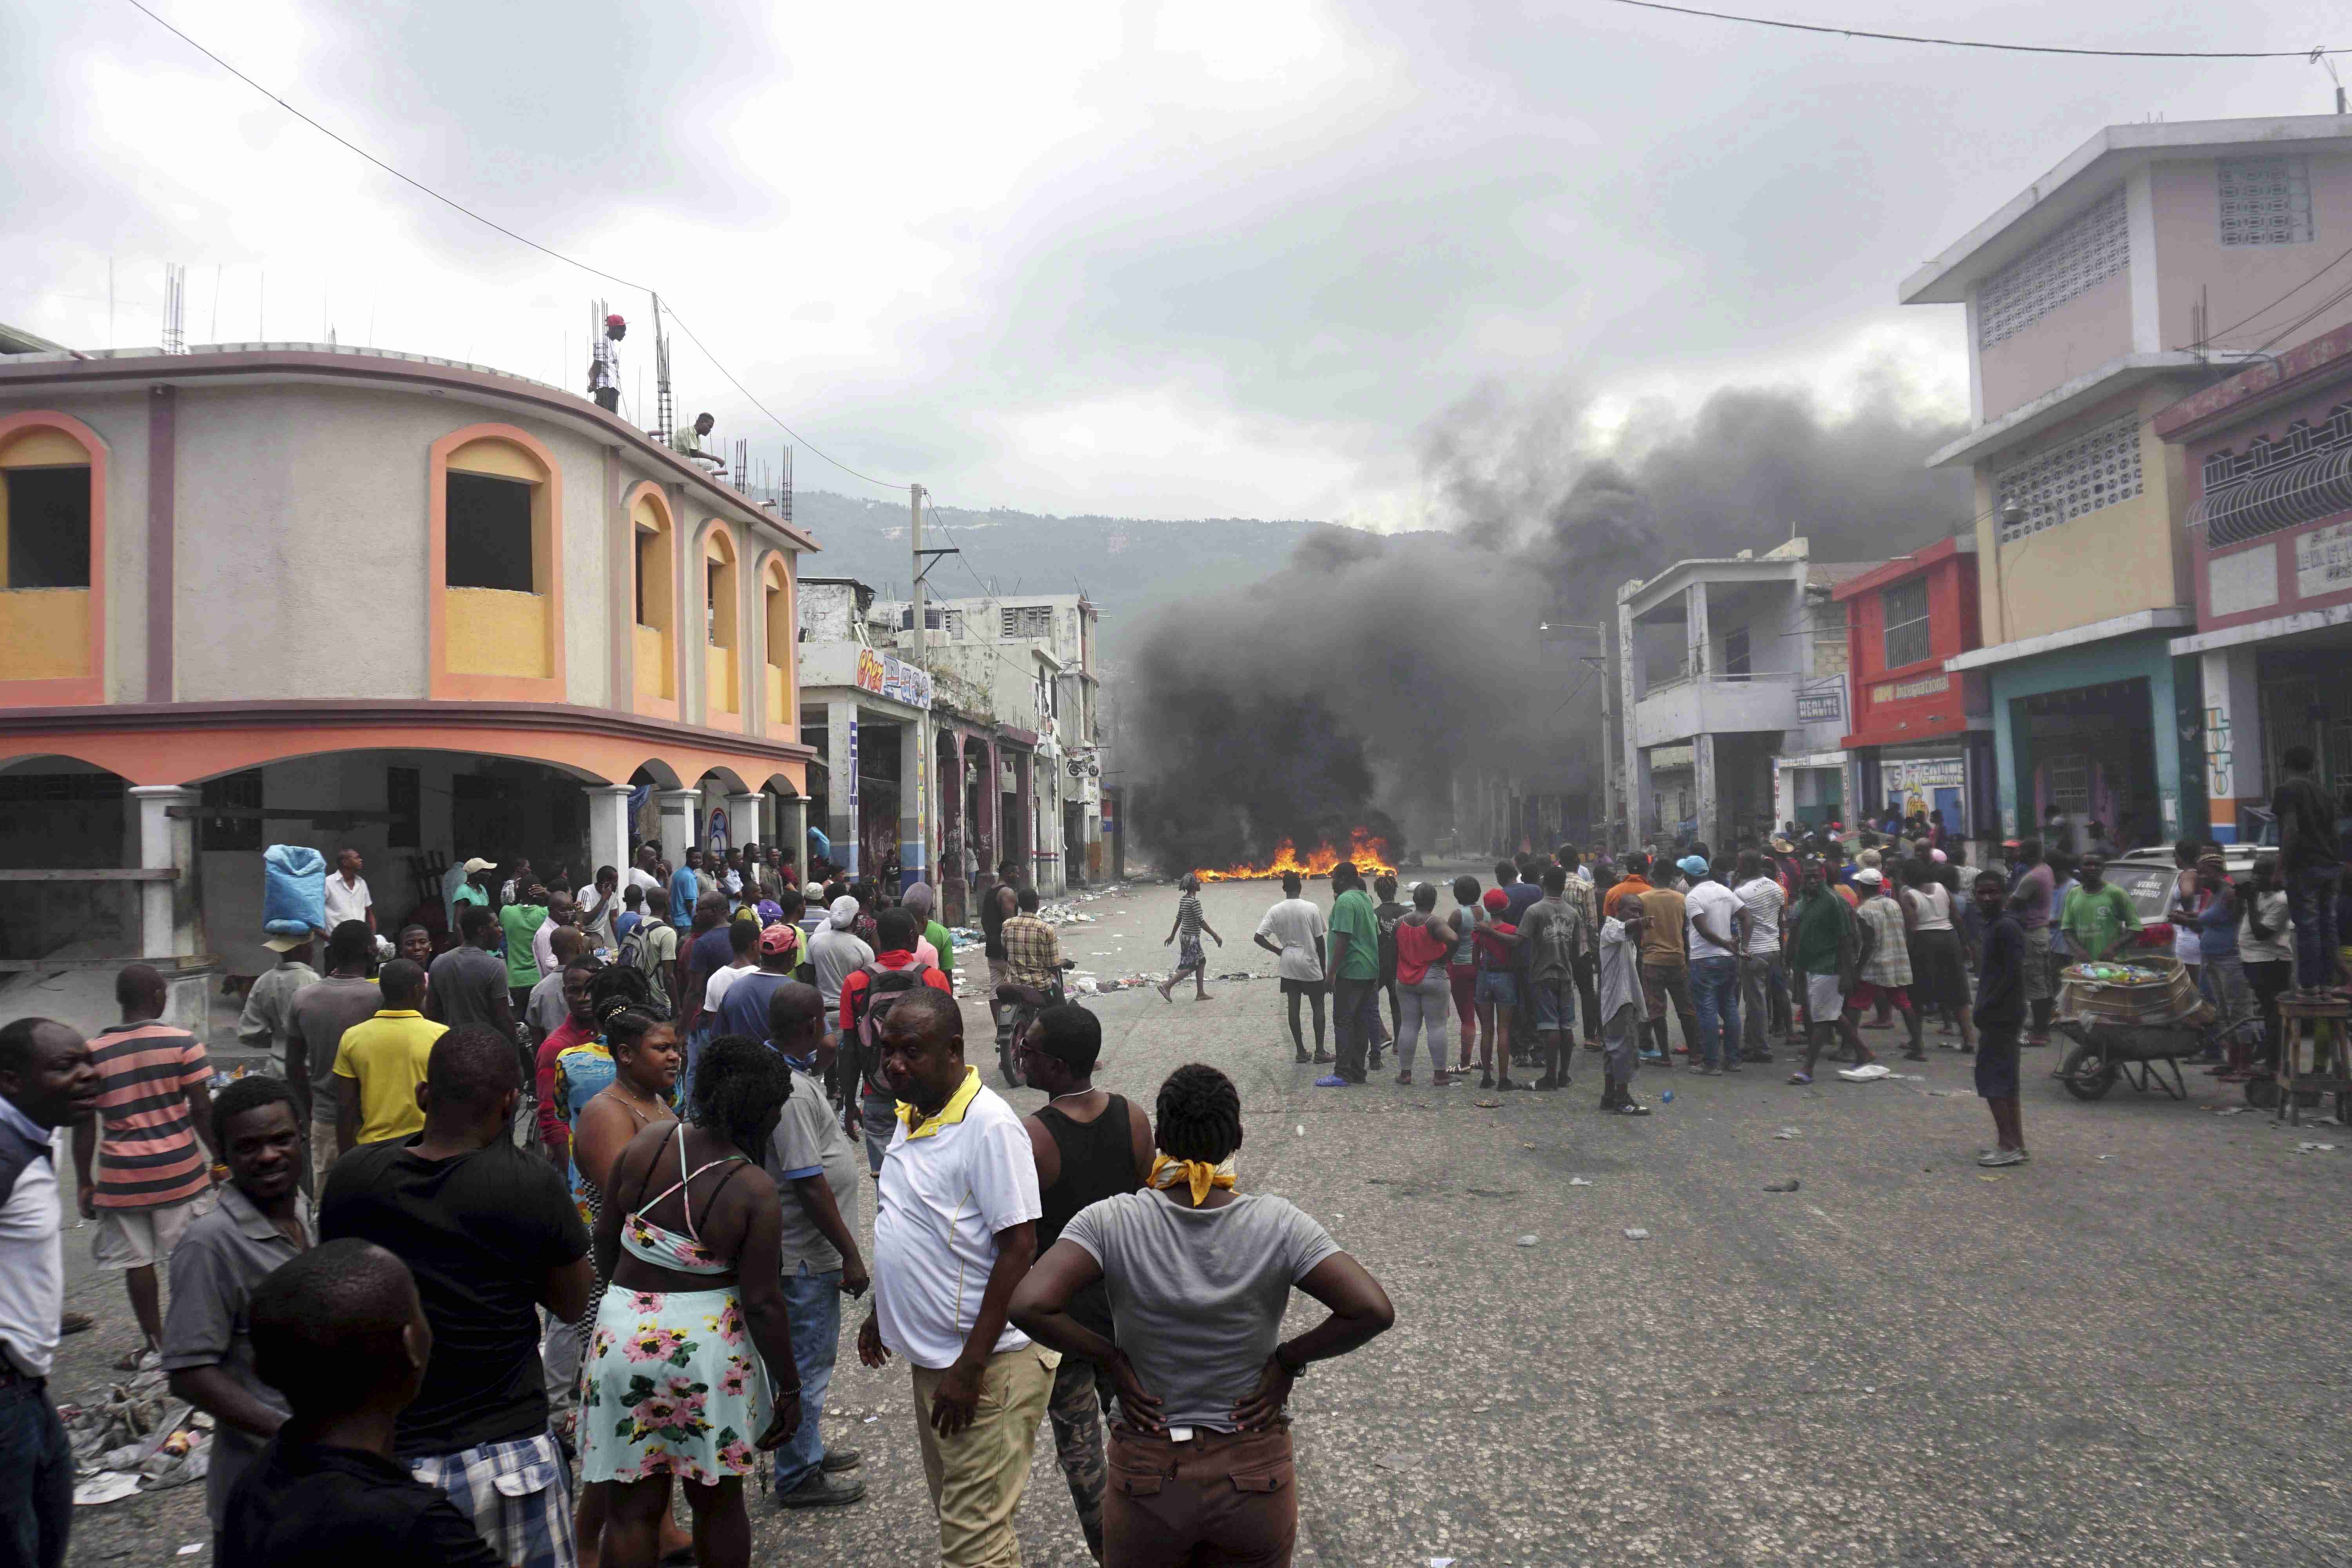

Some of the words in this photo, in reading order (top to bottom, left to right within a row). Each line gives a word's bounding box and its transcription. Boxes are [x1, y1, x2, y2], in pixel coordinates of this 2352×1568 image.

[857, 649, 884, 693] Chez
[1896, 674, 1950, 699] International
[1799, 697, 1838, 719] REALITE
[2207, 707, 2233, 795] LOTO
